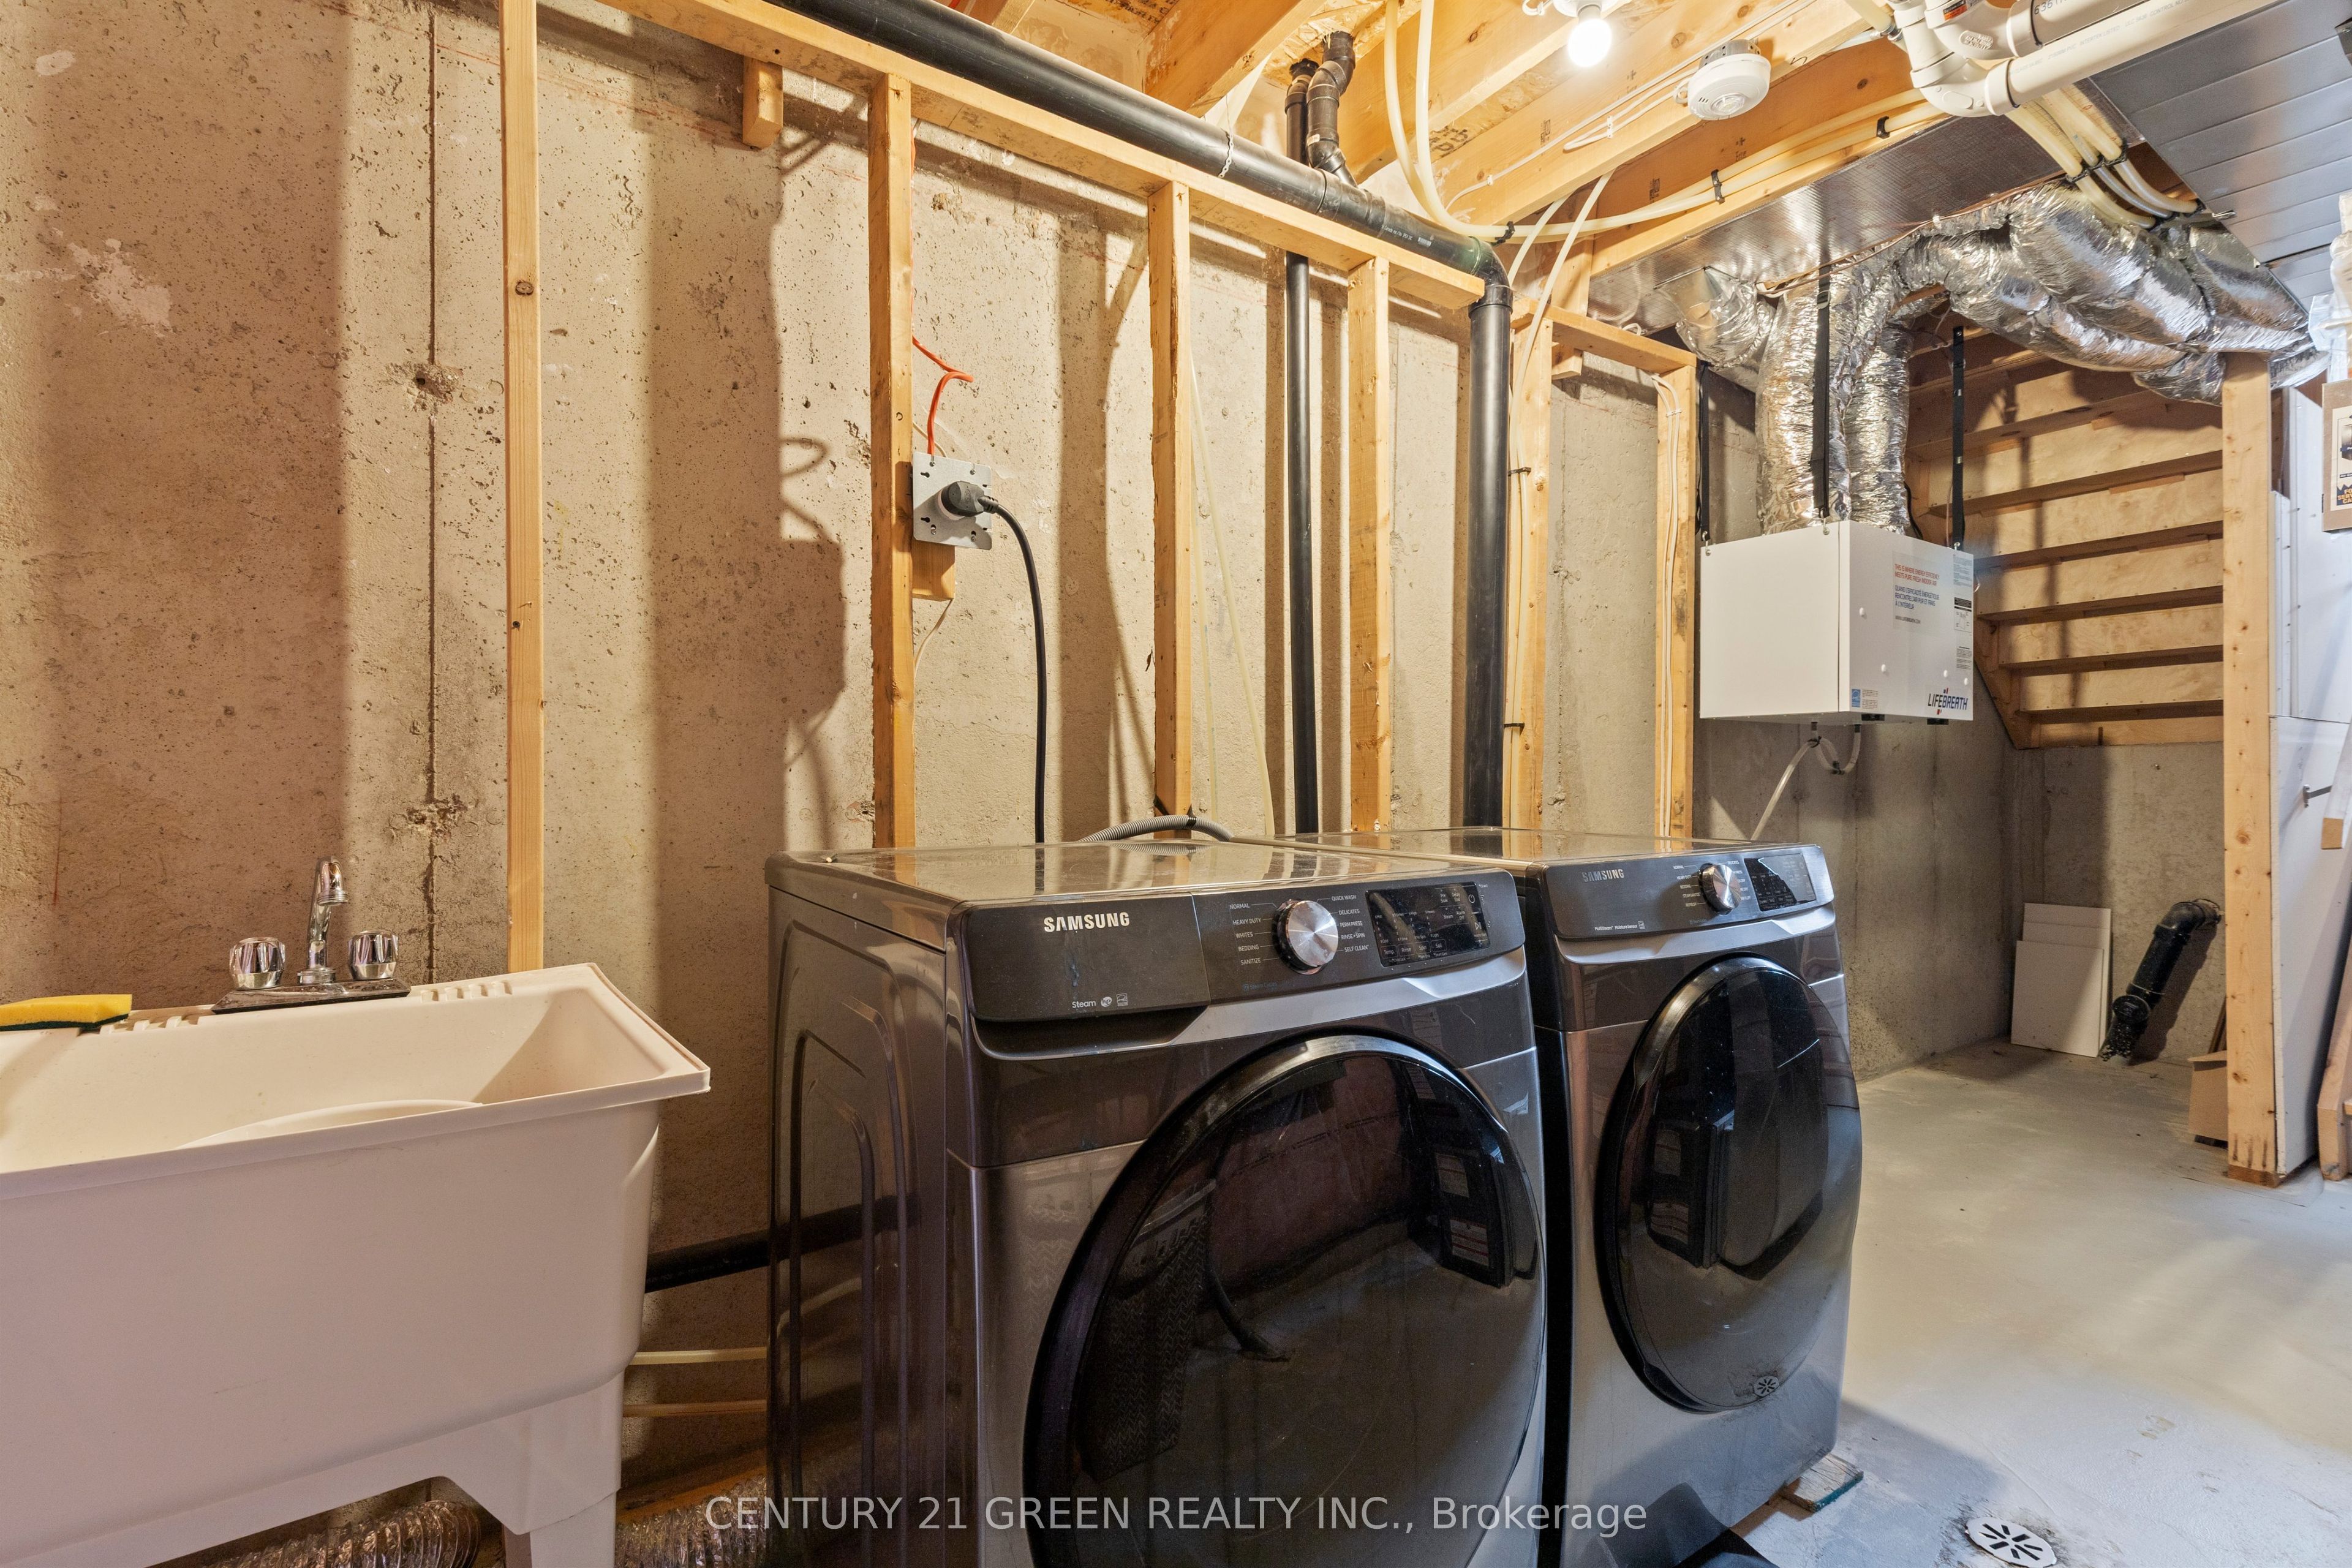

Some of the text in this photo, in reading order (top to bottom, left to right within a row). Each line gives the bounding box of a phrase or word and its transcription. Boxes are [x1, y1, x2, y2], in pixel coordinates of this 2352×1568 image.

[1928, 693, 1969, 710] LIFEBREATH
[1581, 869, 1624, 882] SAMSUNG
[1044, 912, 1130, 932] SAMSUNG
[1072, 1000, 1096, 1008] Steam
